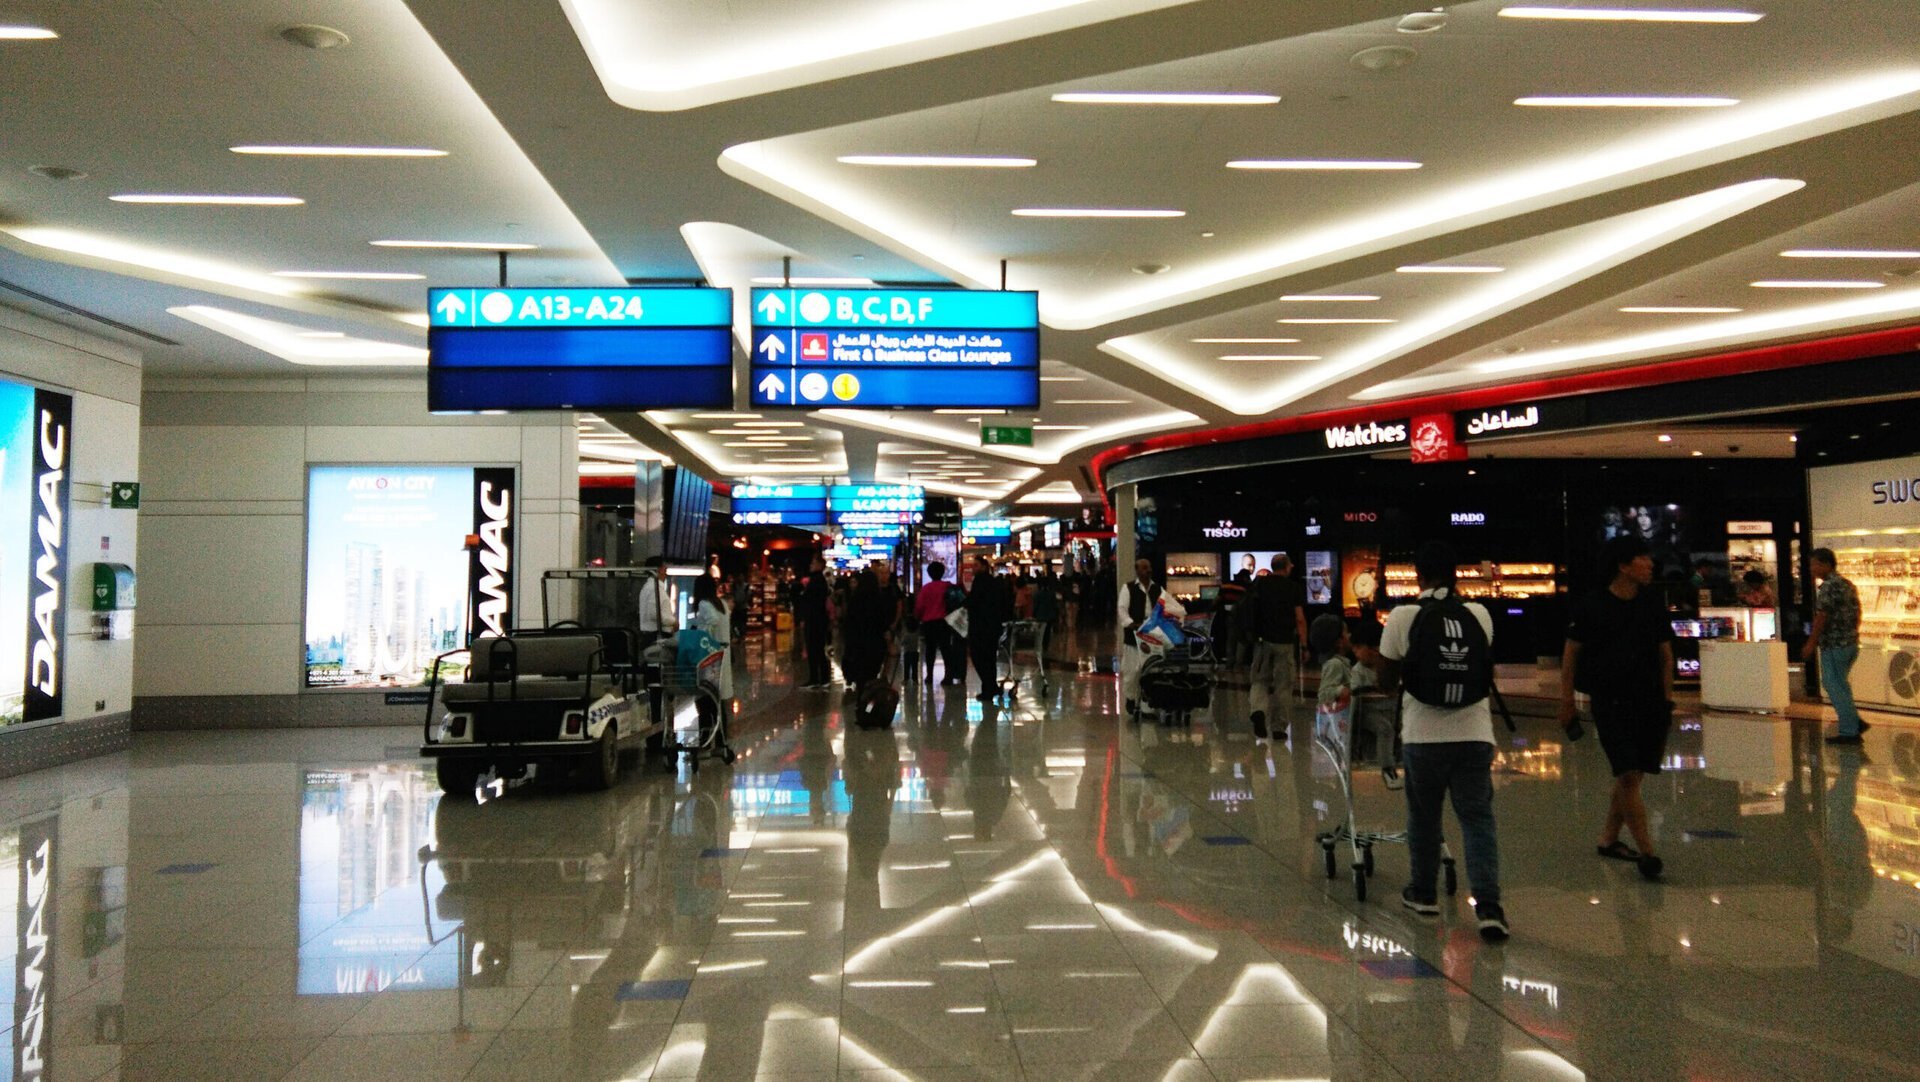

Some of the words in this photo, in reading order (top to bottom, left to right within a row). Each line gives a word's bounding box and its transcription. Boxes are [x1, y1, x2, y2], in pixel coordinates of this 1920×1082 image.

[518, 295, 644, 321] A13-A24
[927, 348, 959, 363] Class
[959, 348, 1012, 366] Lounges
[1467, 406, 1539, 435] الساعات
[1325, 421, 1407, 449] Watches
[1344, 512, 1377, 522] MIDO
[1451, 512, 1485, 522] RADO
[1202, 527, 1248, 538] TISSOT
[32, 408, 65, 698] DAMAC
[1438, 662, 1469, 671] adidas
